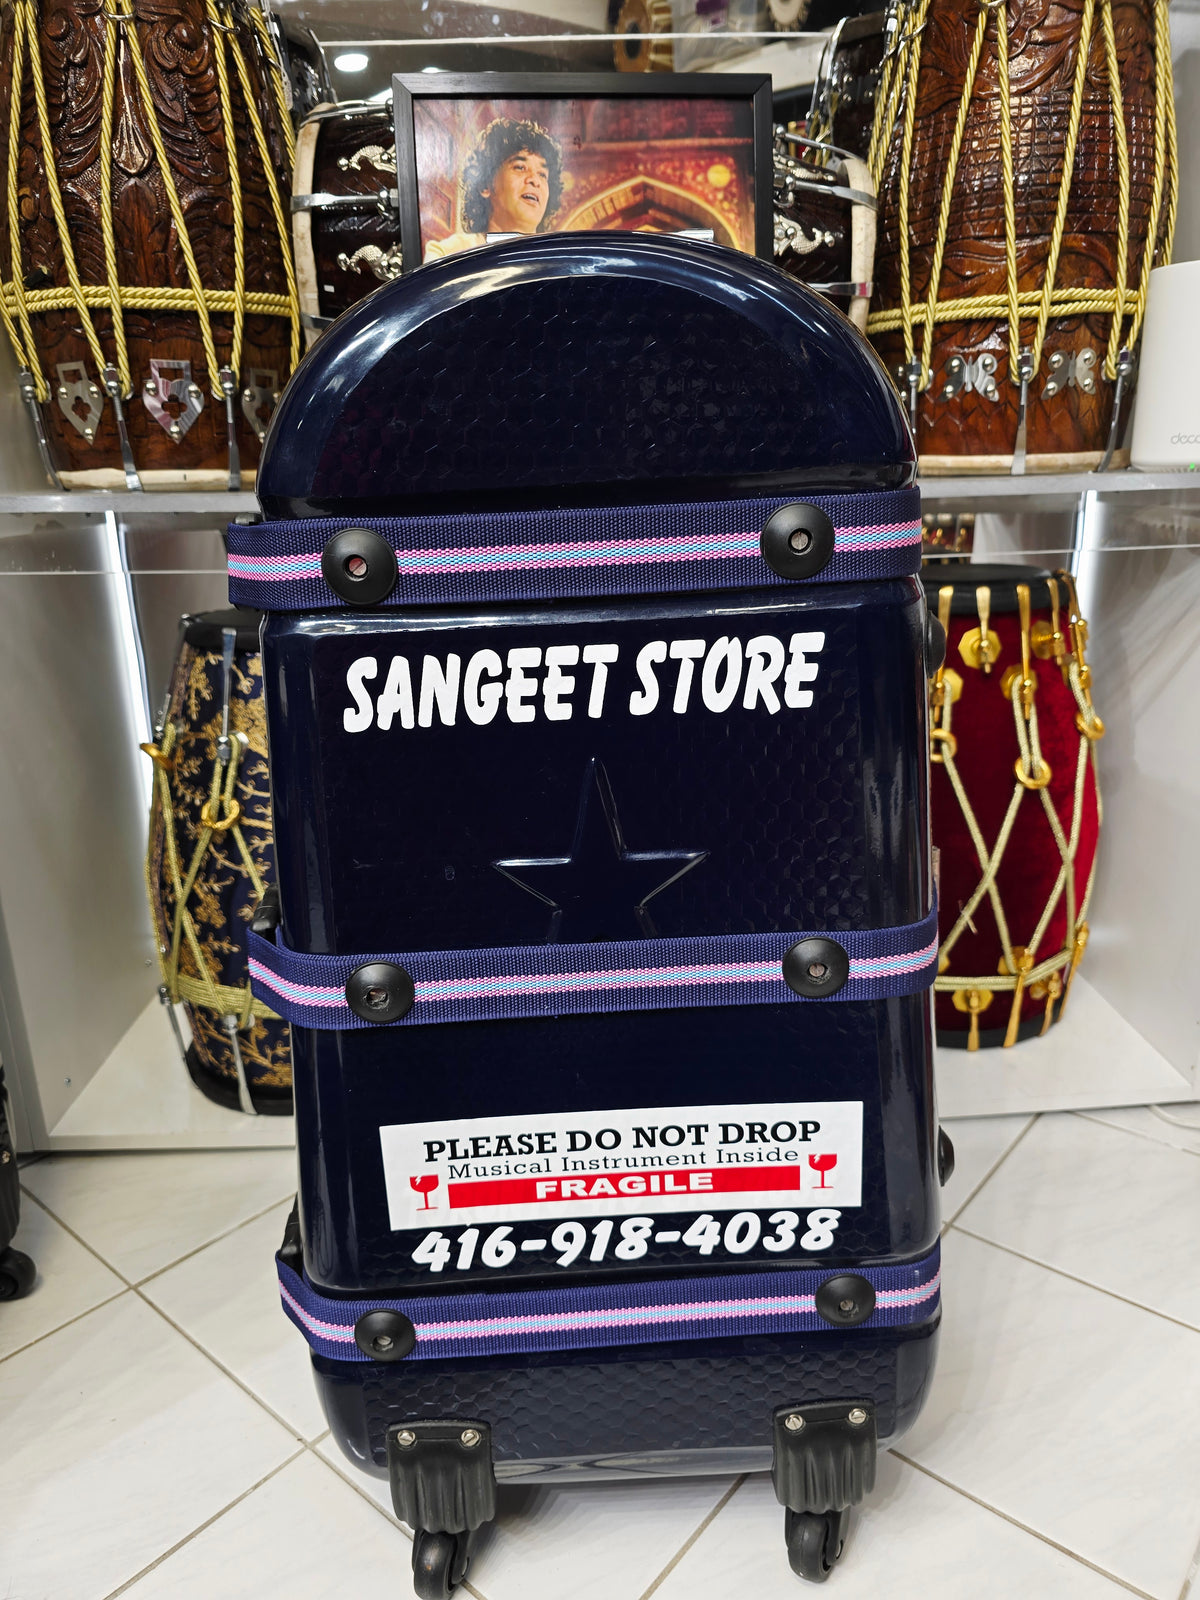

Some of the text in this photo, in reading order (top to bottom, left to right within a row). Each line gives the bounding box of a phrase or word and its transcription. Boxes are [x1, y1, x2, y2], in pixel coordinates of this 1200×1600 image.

[343, 632, 826, 733] SANGEET STORE
[423, 1120, 821, 1163] PLEASE DO NOT DROP
[448, 1147, 799, 1180] Musical Instrument Inside
[535, 1172, 714, 1199] FRAGILE
[411, 1208, 842, 1272] 416-918-4038
